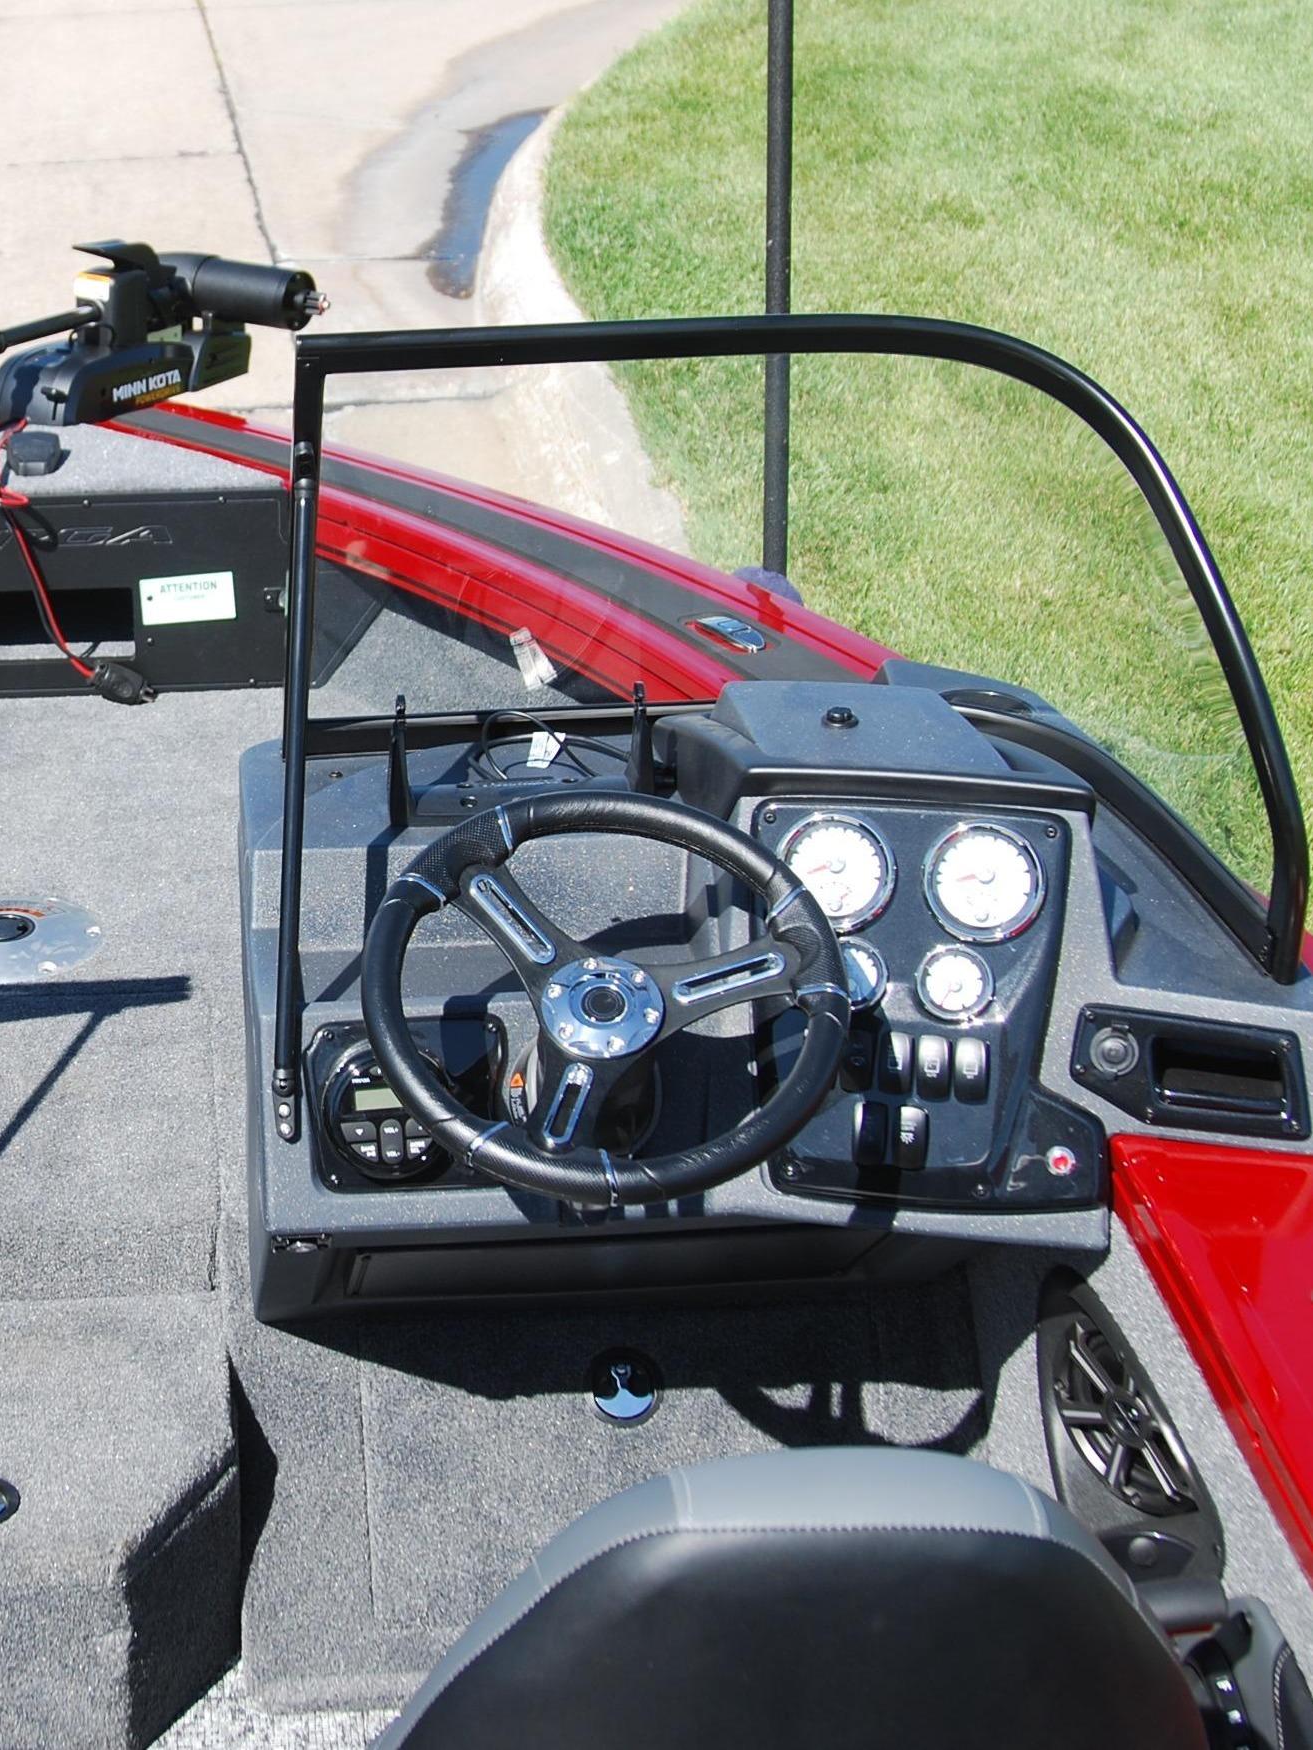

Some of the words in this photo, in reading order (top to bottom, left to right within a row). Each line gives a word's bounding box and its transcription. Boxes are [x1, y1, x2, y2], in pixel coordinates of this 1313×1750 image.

[112, 379, 147, 402] MINN
[148, 369, 181, 391] KOTA
[160, 580, 218, 593] ATTENTION
